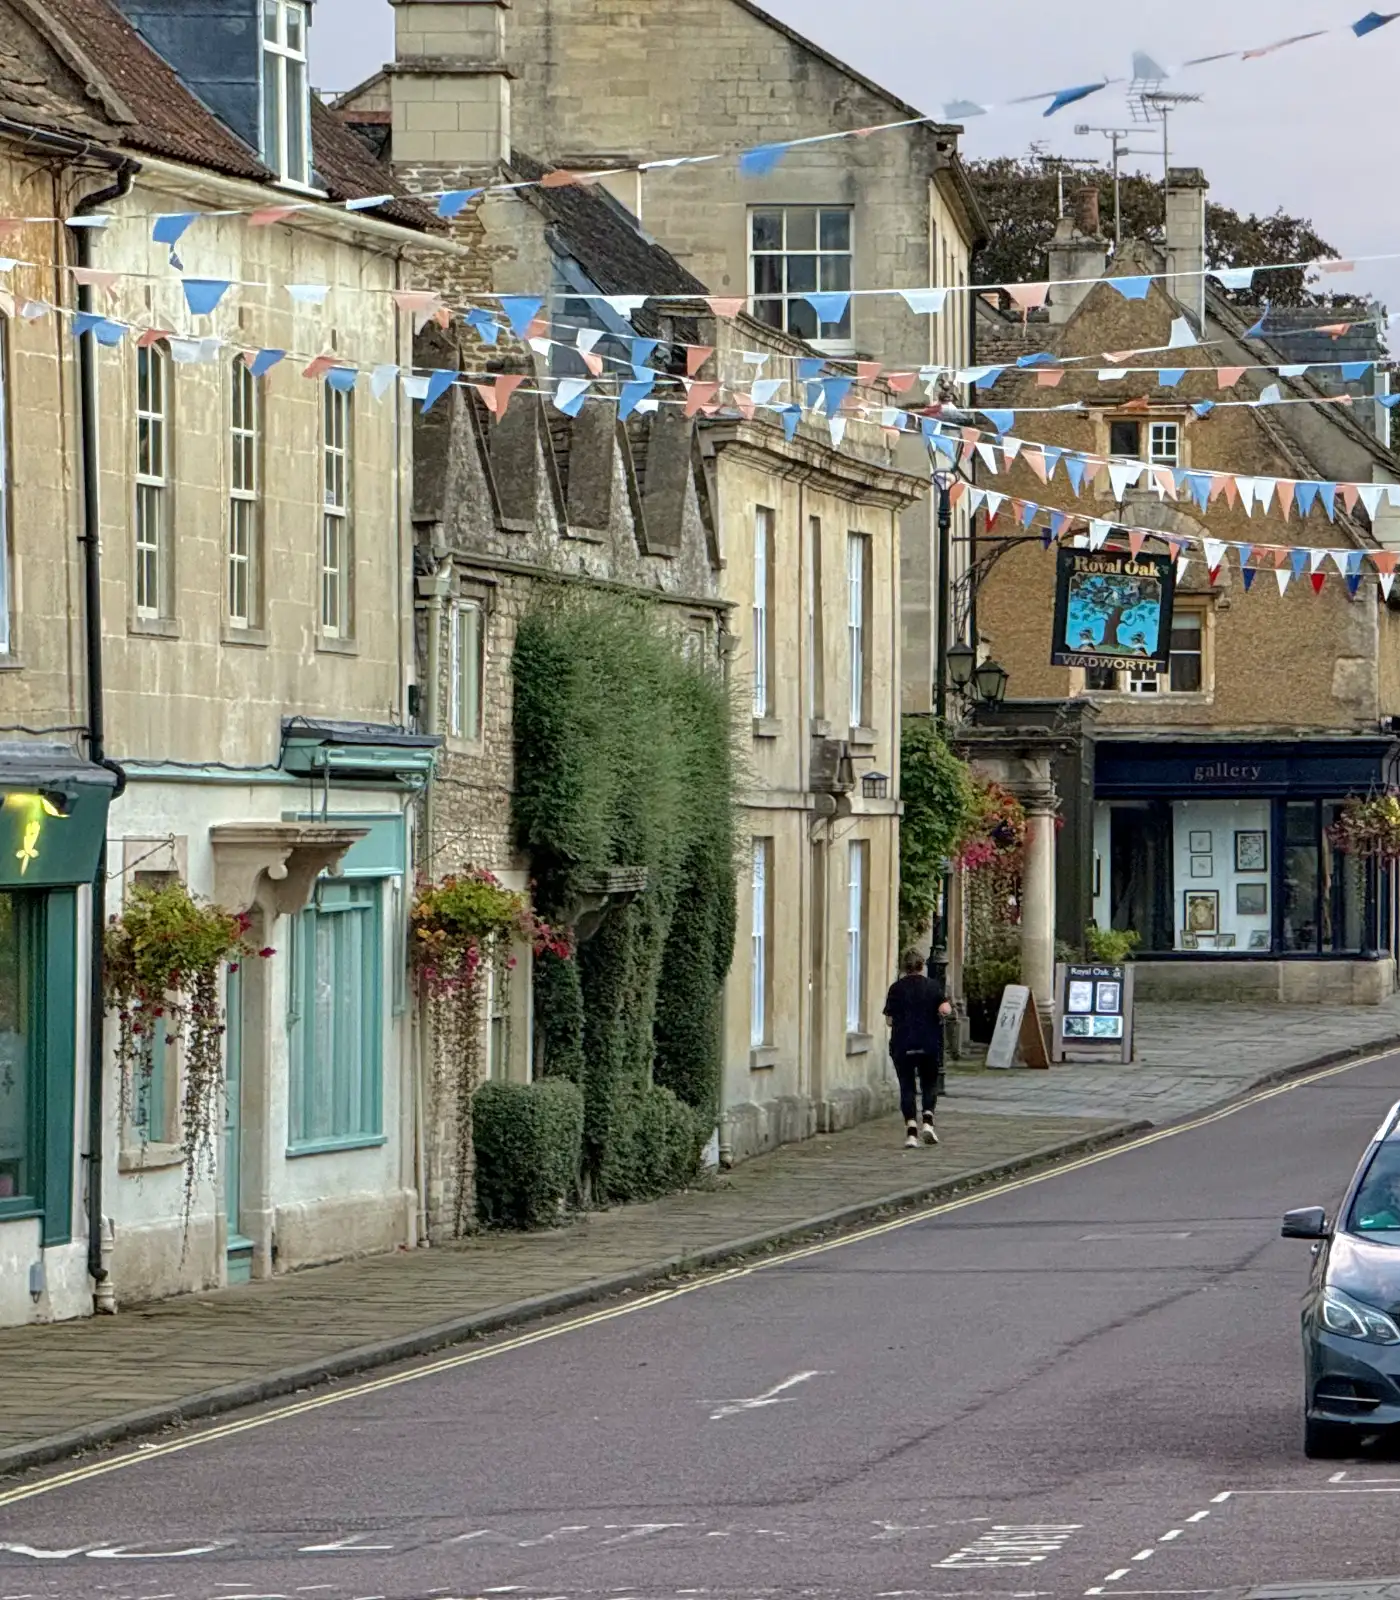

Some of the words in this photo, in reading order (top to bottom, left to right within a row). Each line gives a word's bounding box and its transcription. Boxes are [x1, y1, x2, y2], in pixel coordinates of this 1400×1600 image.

[1073, 555, 1120, 574] Royal
[1124, 560, 1161, 577] Oak
[1062, 655, 1157, 671] WADWORTH
[1194, 762, 1262, 780] gallery
[1070, 967, 1092, 976] Royal
[1093, 968, 1110, 976] Oak
